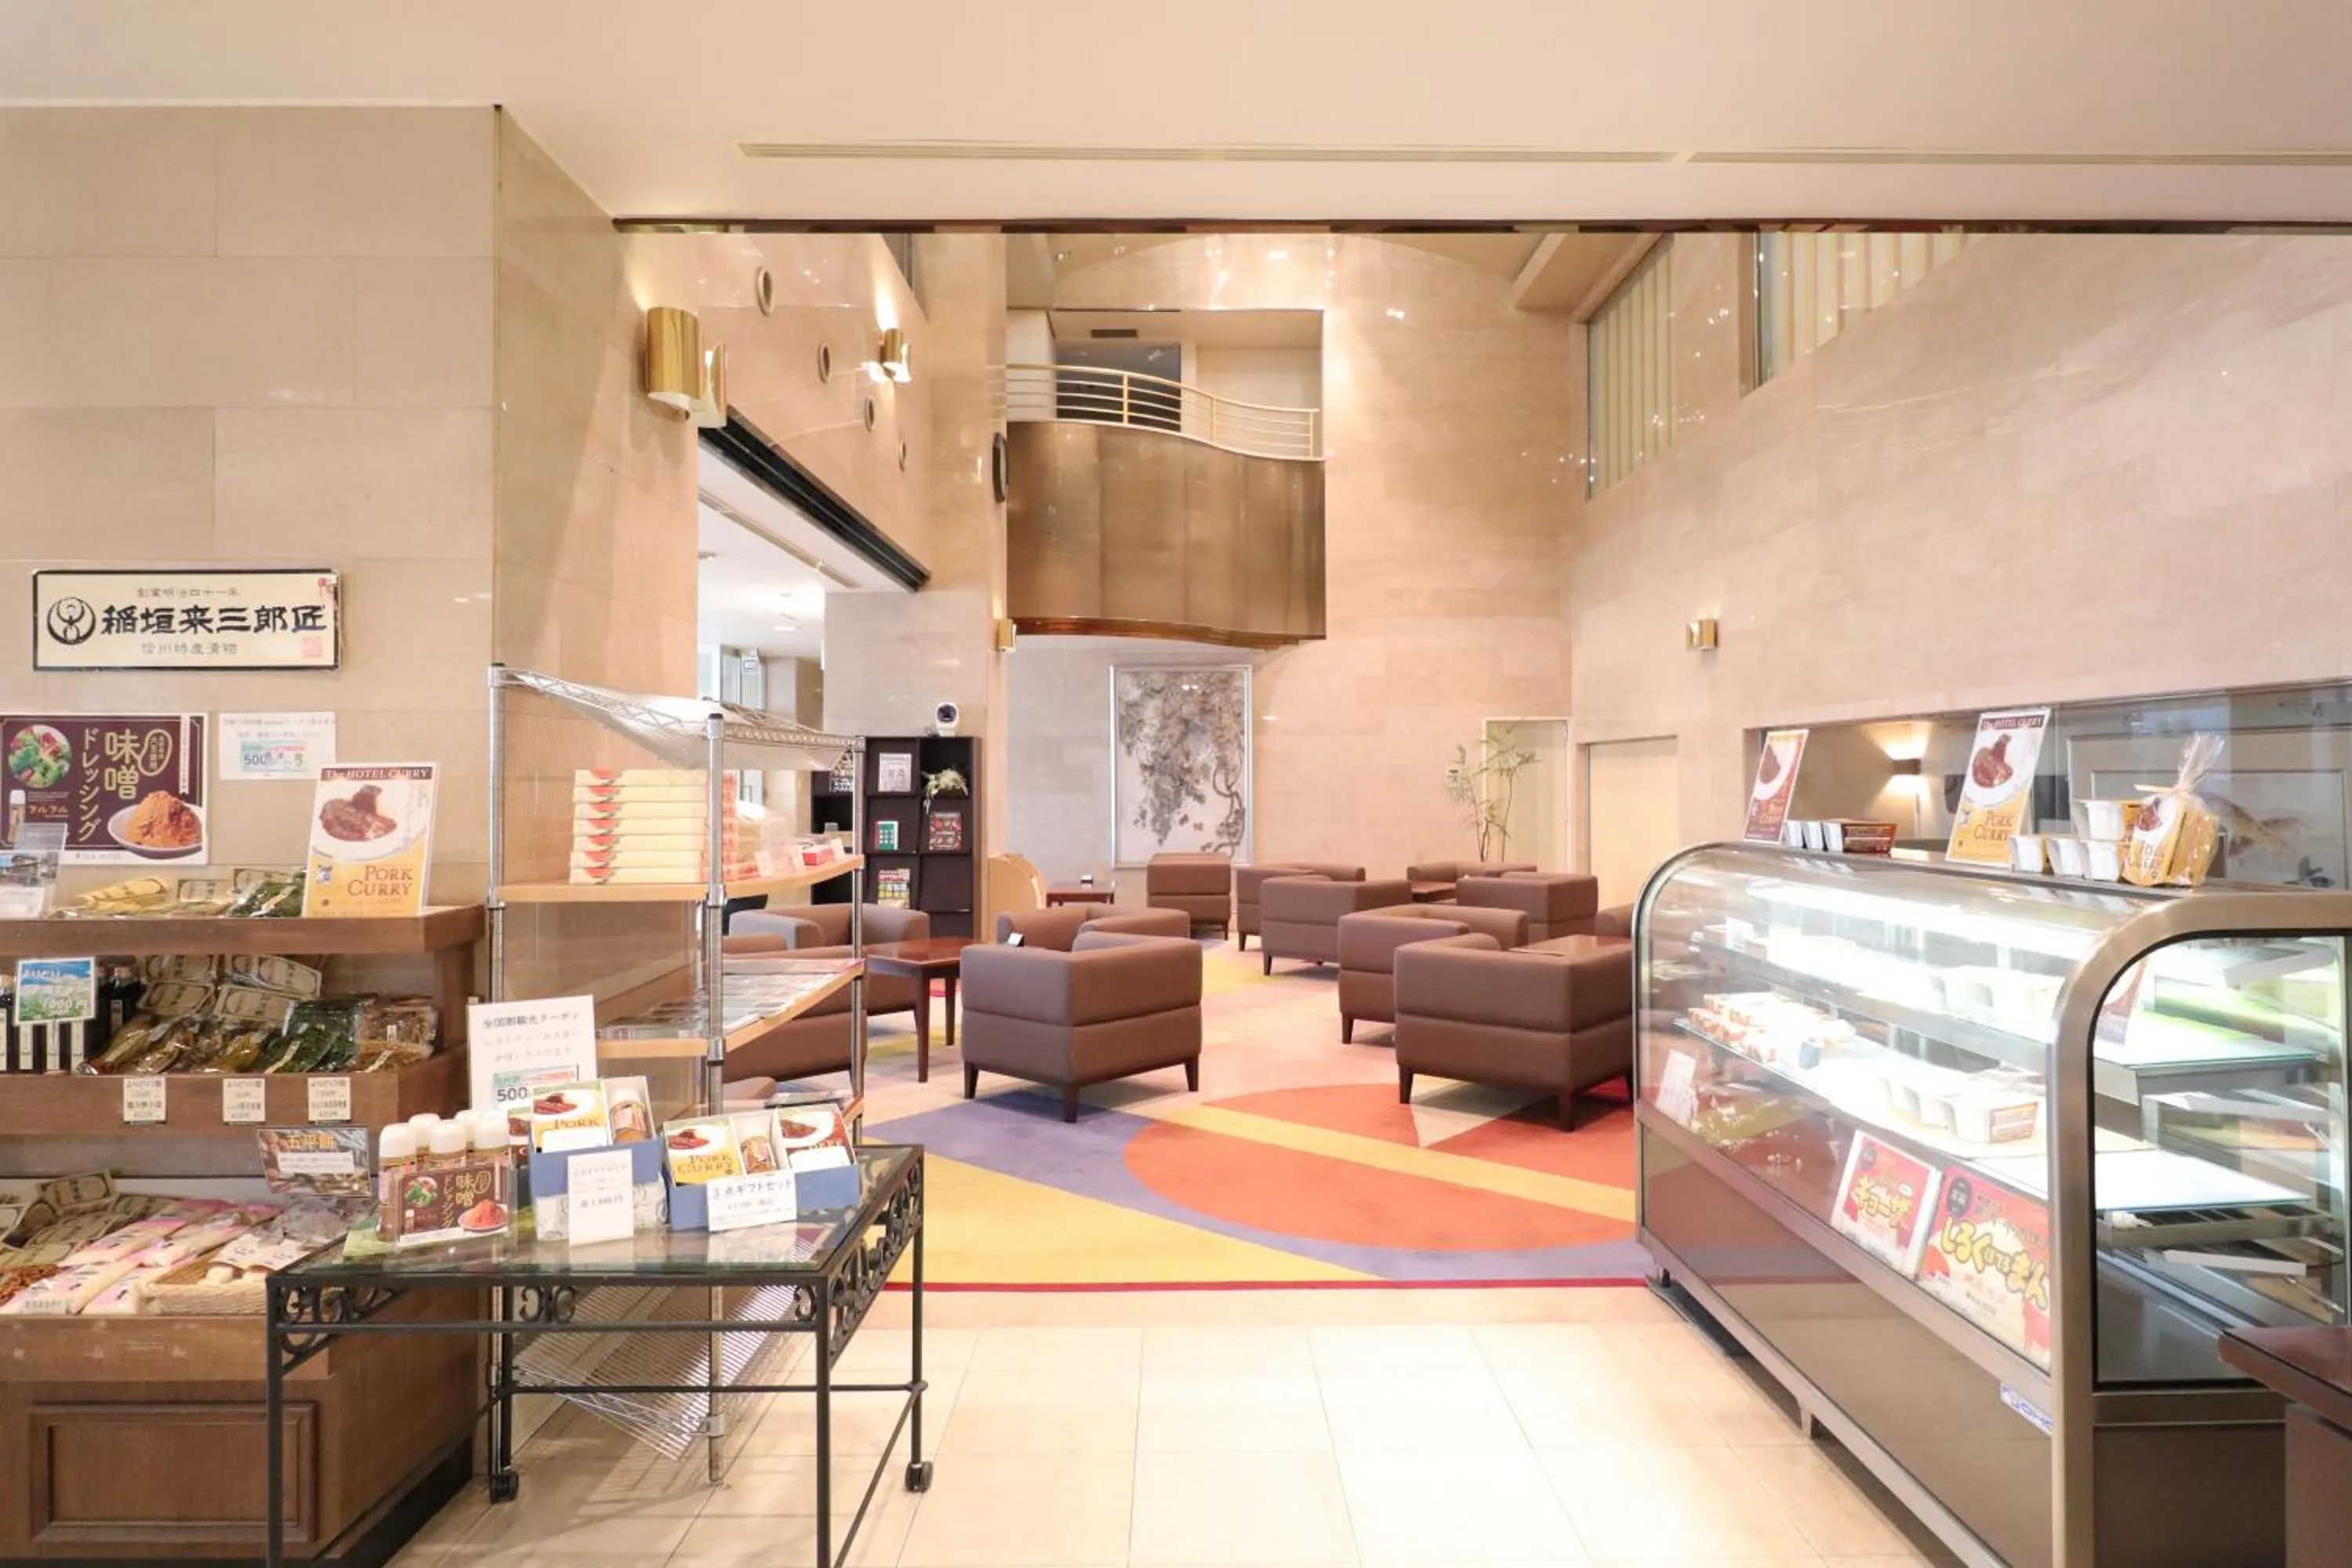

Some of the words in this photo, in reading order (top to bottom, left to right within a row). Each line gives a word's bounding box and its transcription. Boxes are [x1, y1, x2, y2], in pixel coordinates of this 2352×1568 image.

[100, 604, 327, 636] 稲垣来三郎匠
[104, 728, 140, 800] 味噌
[348, 769, 387, 779] HOTEL
[79, 728, 102, 842] ドレッシング
[365, 866, 413, 880] PORK
[347, 880, 413, 896] CURRY
[496, 1087, 528, 1102] 500
